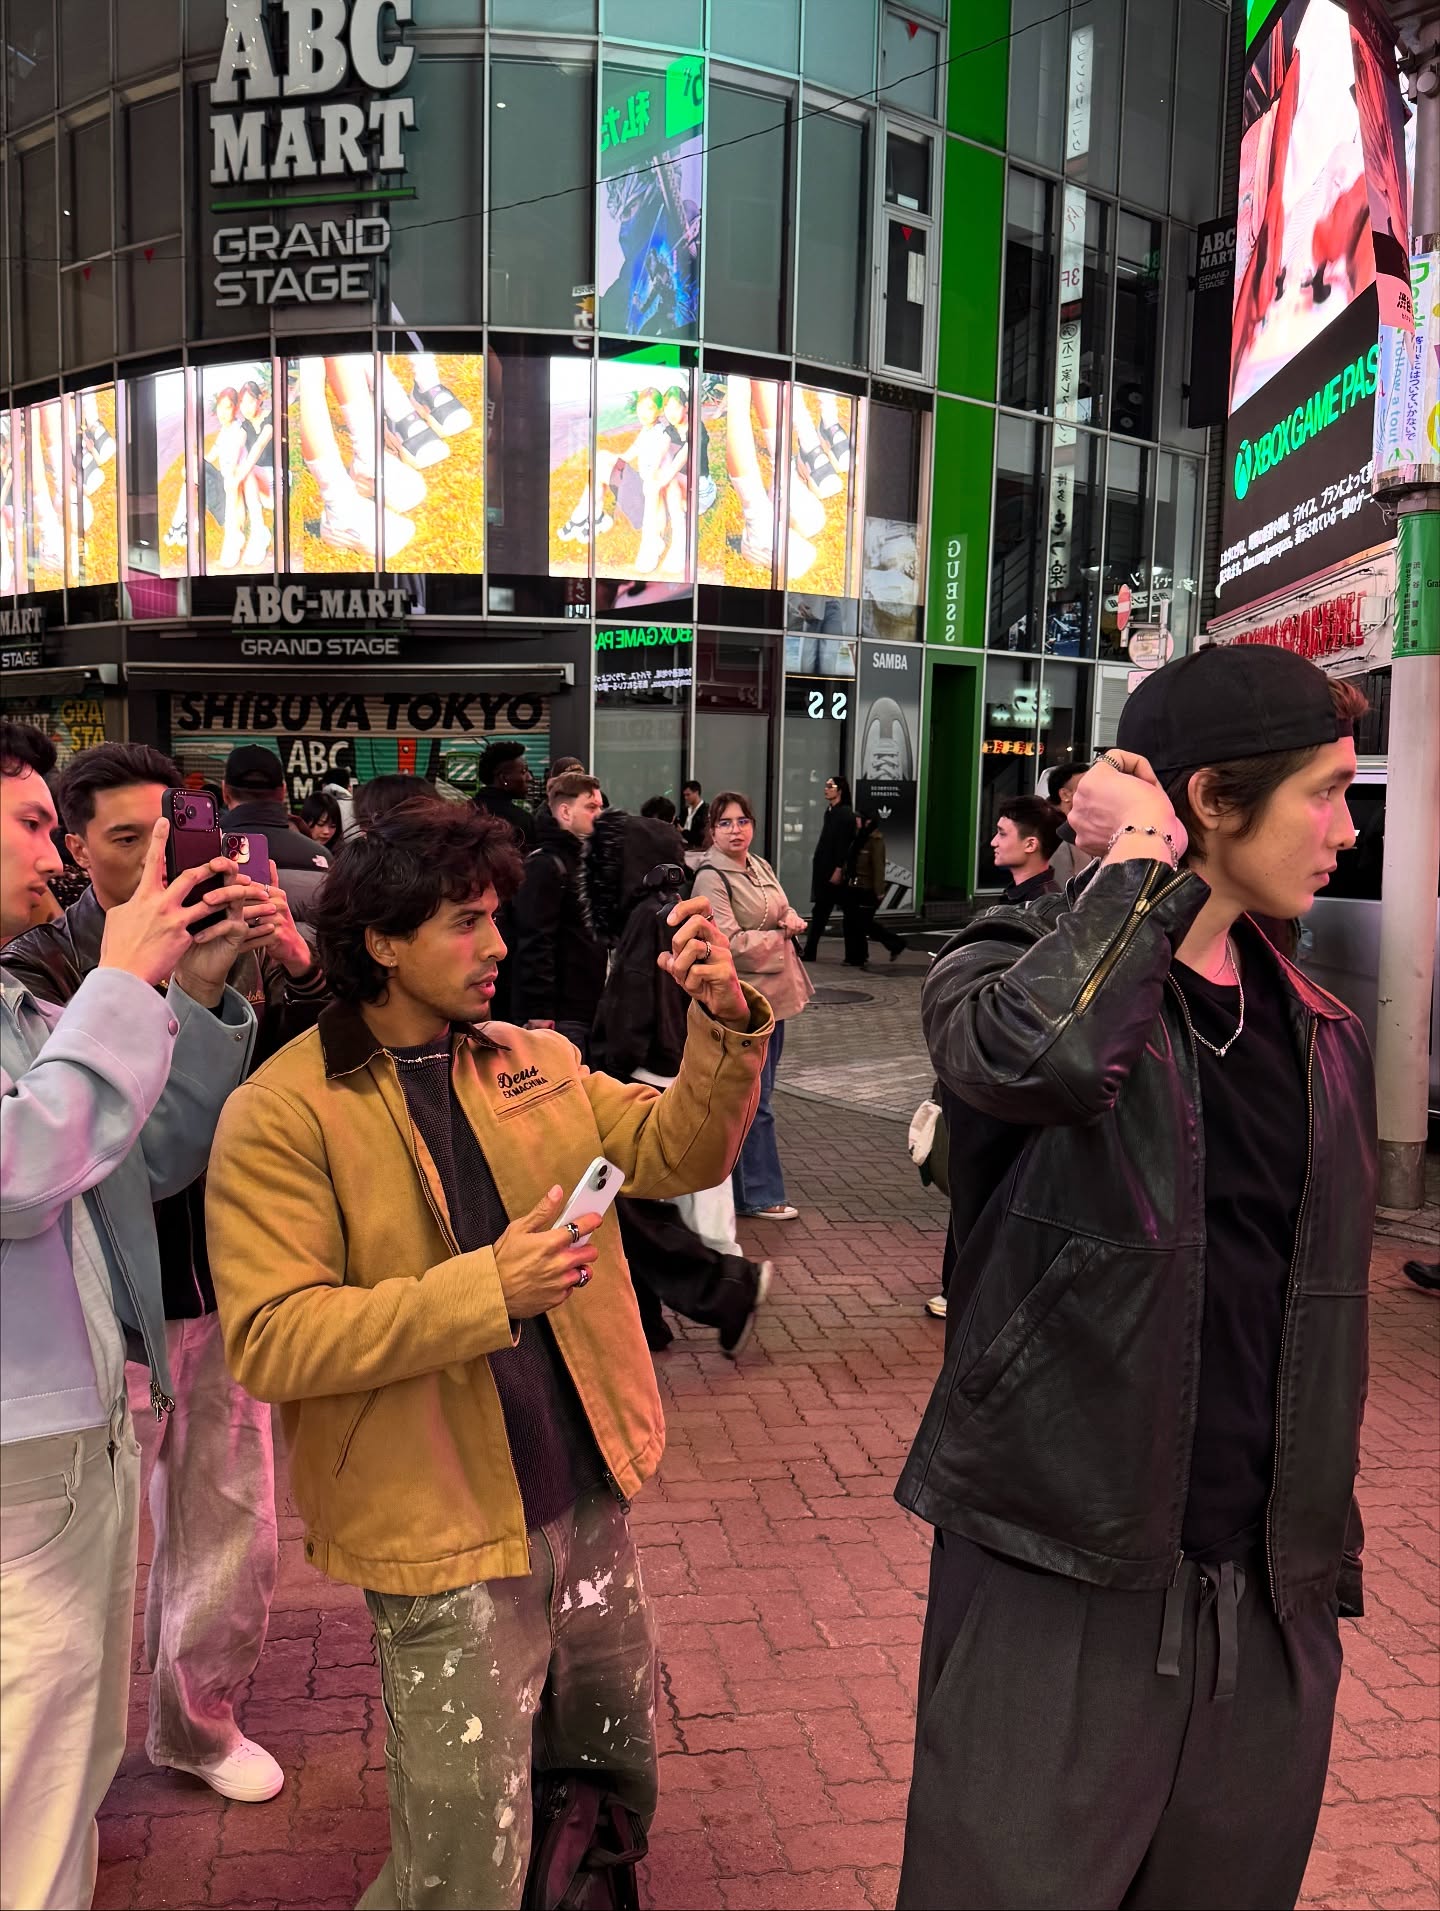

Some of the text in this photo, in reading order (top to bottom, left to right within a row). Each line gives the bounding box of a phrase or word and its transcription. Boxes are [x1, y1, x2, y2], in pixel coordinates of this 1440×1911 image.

[210, 0, 414, 103] ABC
[210, 98, 415, 184] MART
[213, 217, 390, 263] GRAND
[1201, 227, 1236, 255] ABC
[1200, 248, 1235, 269] MART
[214, 263, 369, 307] STAGE
[1199, 270, 1229, 284] GRAND
[1199, 278, 1225, 292] STAGE
[1252, 413, 1291, 480] XBOX
[1290, 373, 1343, 451] GAME
[1388, 410, 1400, 444] tout
[231, 585, 407, 624] ABC-MART
[1, 651, 40, 668] STAGE
[241, 638, 399, 656] GRAND STAGE
[872, 652, 908, 671] SAMBA
[62, 700, 105, 724] GRA
[177, 691, 544, 732] SHIBUYA TOKYO
[287, 739, 352, 774] ABC
[497, 1065, 539, 1088] Deus
